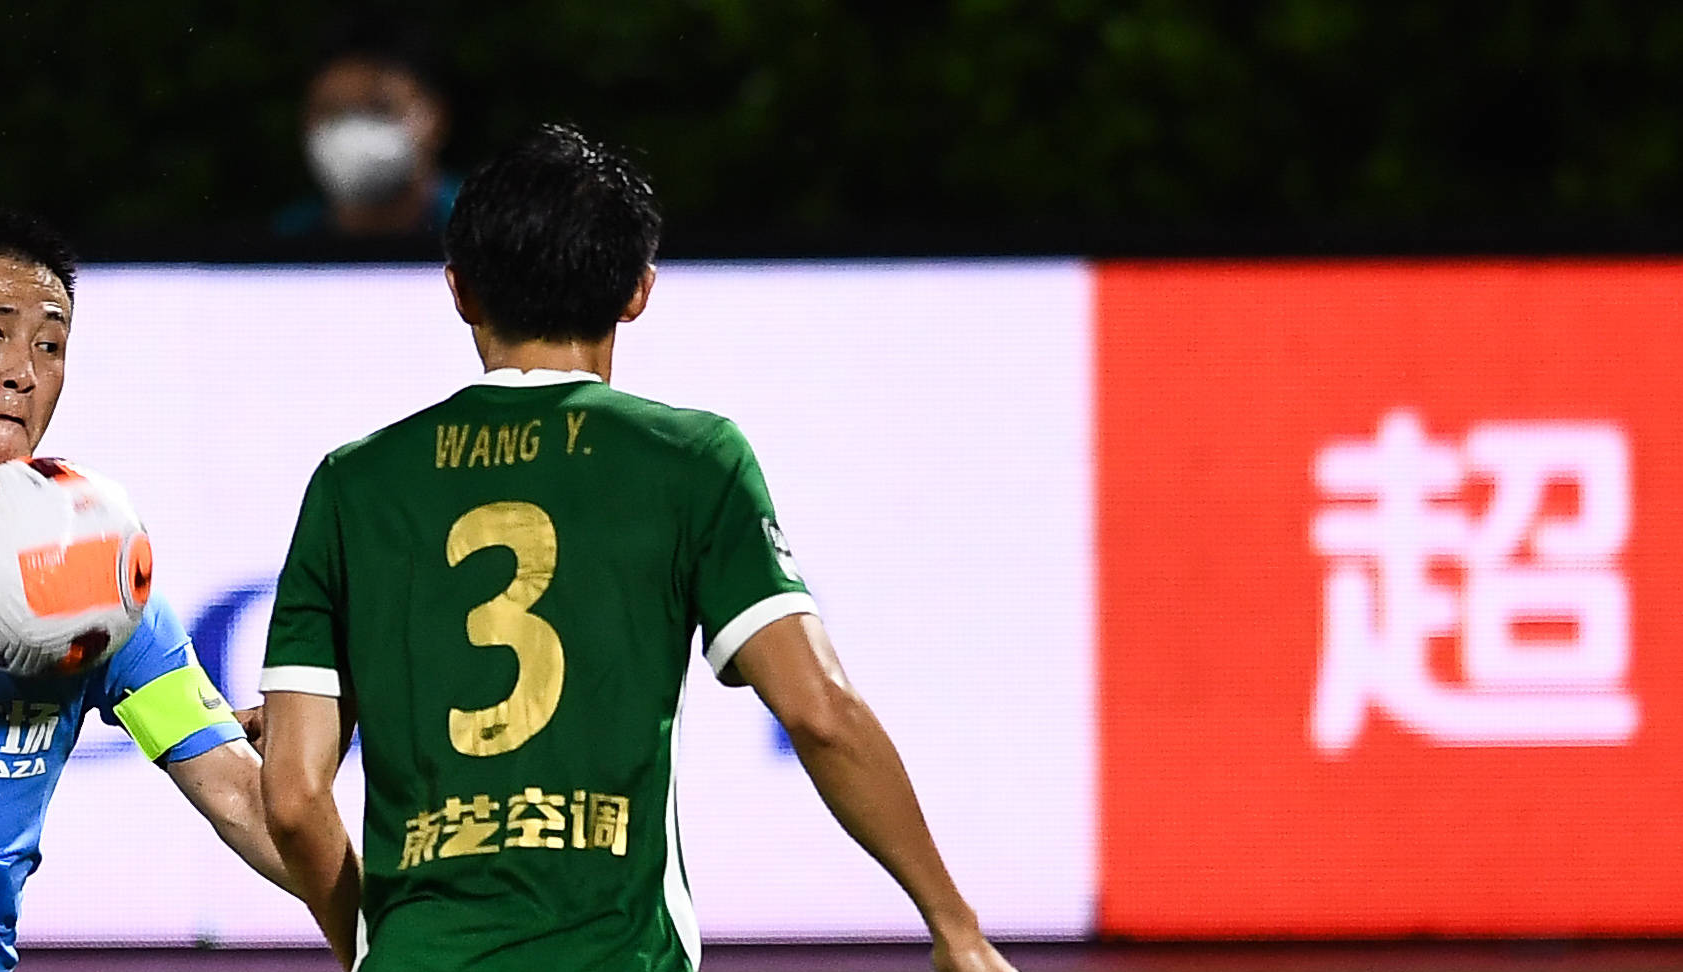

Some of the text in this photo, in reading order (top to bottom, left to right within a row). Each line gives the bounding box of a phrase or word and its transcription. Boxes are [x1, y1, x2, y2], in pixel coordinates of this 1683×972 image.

[435, 411, 592, 469] WANG Y.
[445, 501, 566, 757] 3
[1311, 410, 1637, 757] 超
